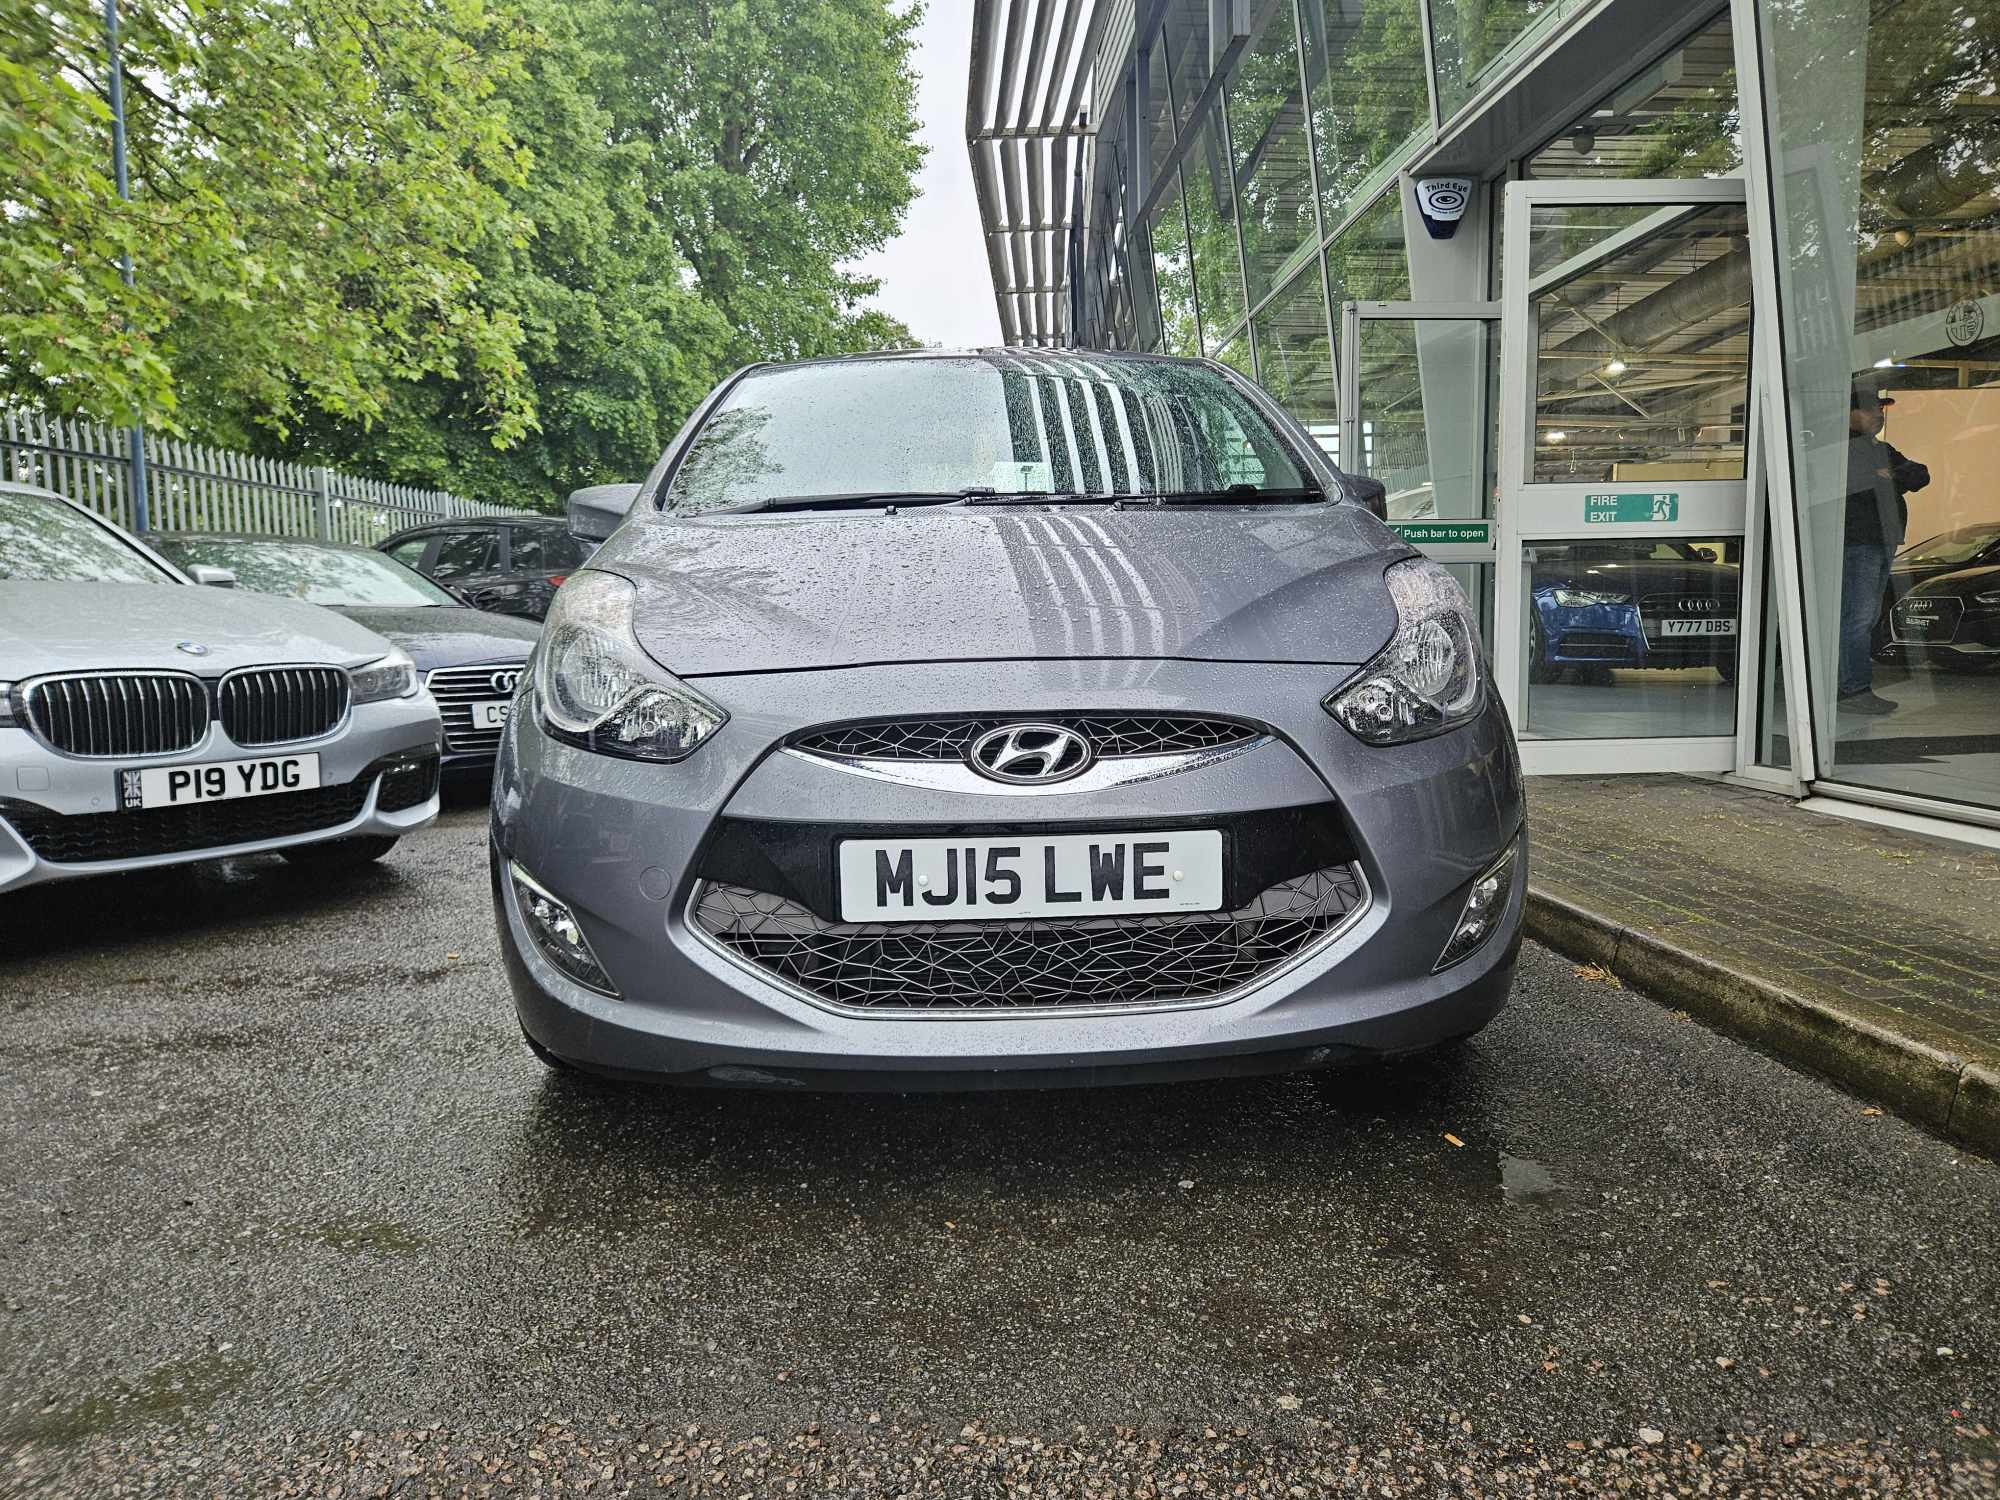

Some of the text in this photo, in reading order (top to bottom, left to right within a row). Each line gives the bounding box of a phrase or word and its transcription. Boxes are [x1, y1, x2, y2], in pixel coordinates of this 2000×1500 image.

[1425, 182, 1469, 192] Third Eye
[1590, 495, 1618, 506] FIRE
[1590, 511, 1617, 522] EXIT
[1404, 529, 1484, 539] Push bar to open
[1668, 620, 1731, 633] Y777 DBS
[168, 759, 300, 802] P19 YDG
[125, 798, 142, 808] UK
[875, 841, 1170, 907] MJ15 LWE
